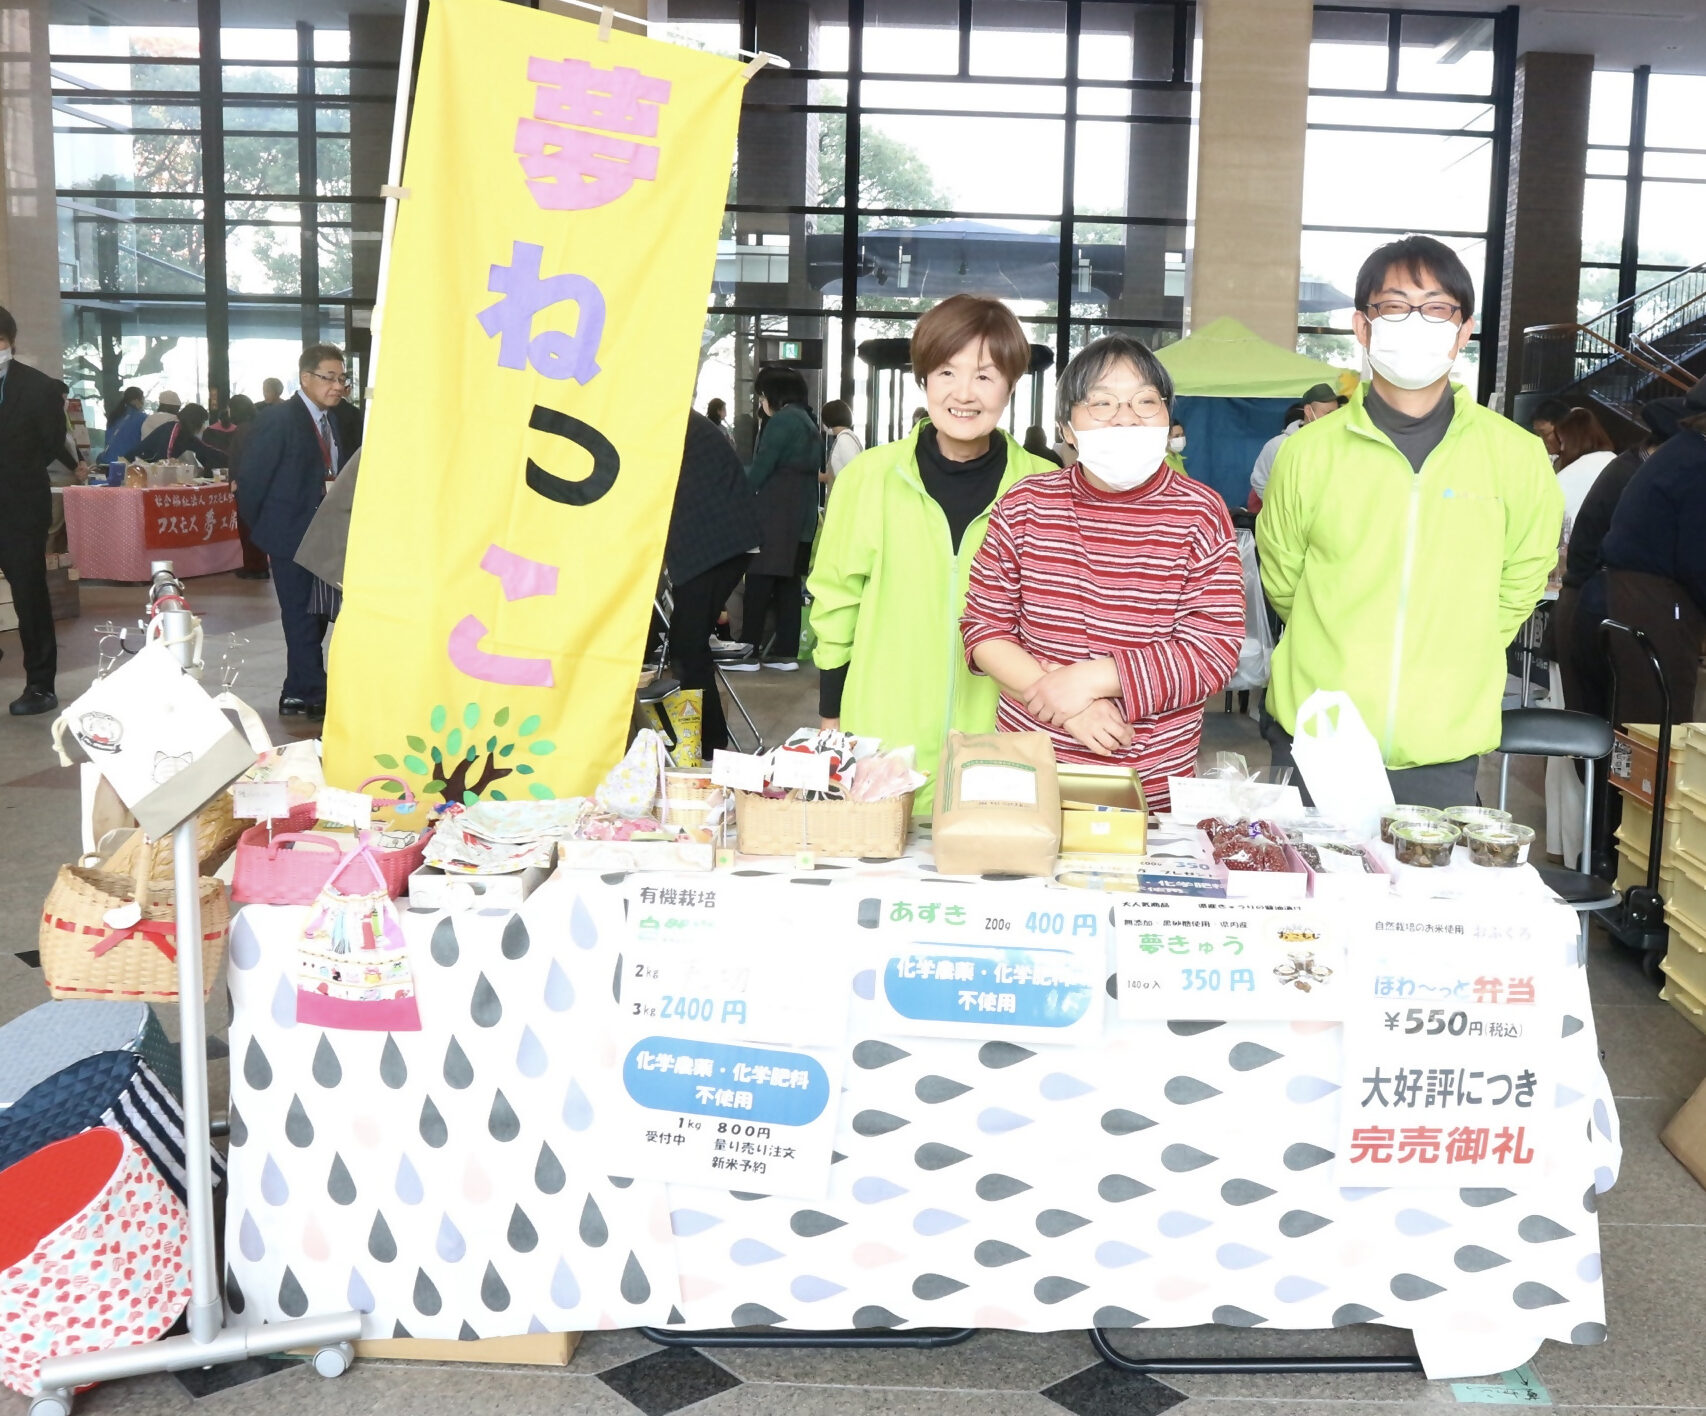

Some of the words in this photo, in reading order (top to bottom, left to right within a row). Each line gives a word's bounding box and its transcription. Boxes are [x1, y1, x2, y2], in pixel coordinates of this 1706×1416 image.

[638, 885, 717, 909] 有機栽培
[889, 899, 967, 927] あずき
[984, 917, 1012, 933] 200g
[1375, 920, 1465, 936] 自然栽培のお米使用
[1138, 932, 1245, 956] 夢きゅう
[957, 991, 1017, 1014] 不使用
[635, 1050, 810, 1090] 化学農薬・化学肥料
[695, 1086, 754, 1110] 不使用
[1361, 1067, 1538, 1109] 大好評につき
[645, 1129, 687, 1147] 受付中
[713, 1137, 797, 1160] 量り売り注文
[1350, 1125, 1535, 1165] 完売御礼
[711, 1155, 768, 1175] 新米予約
